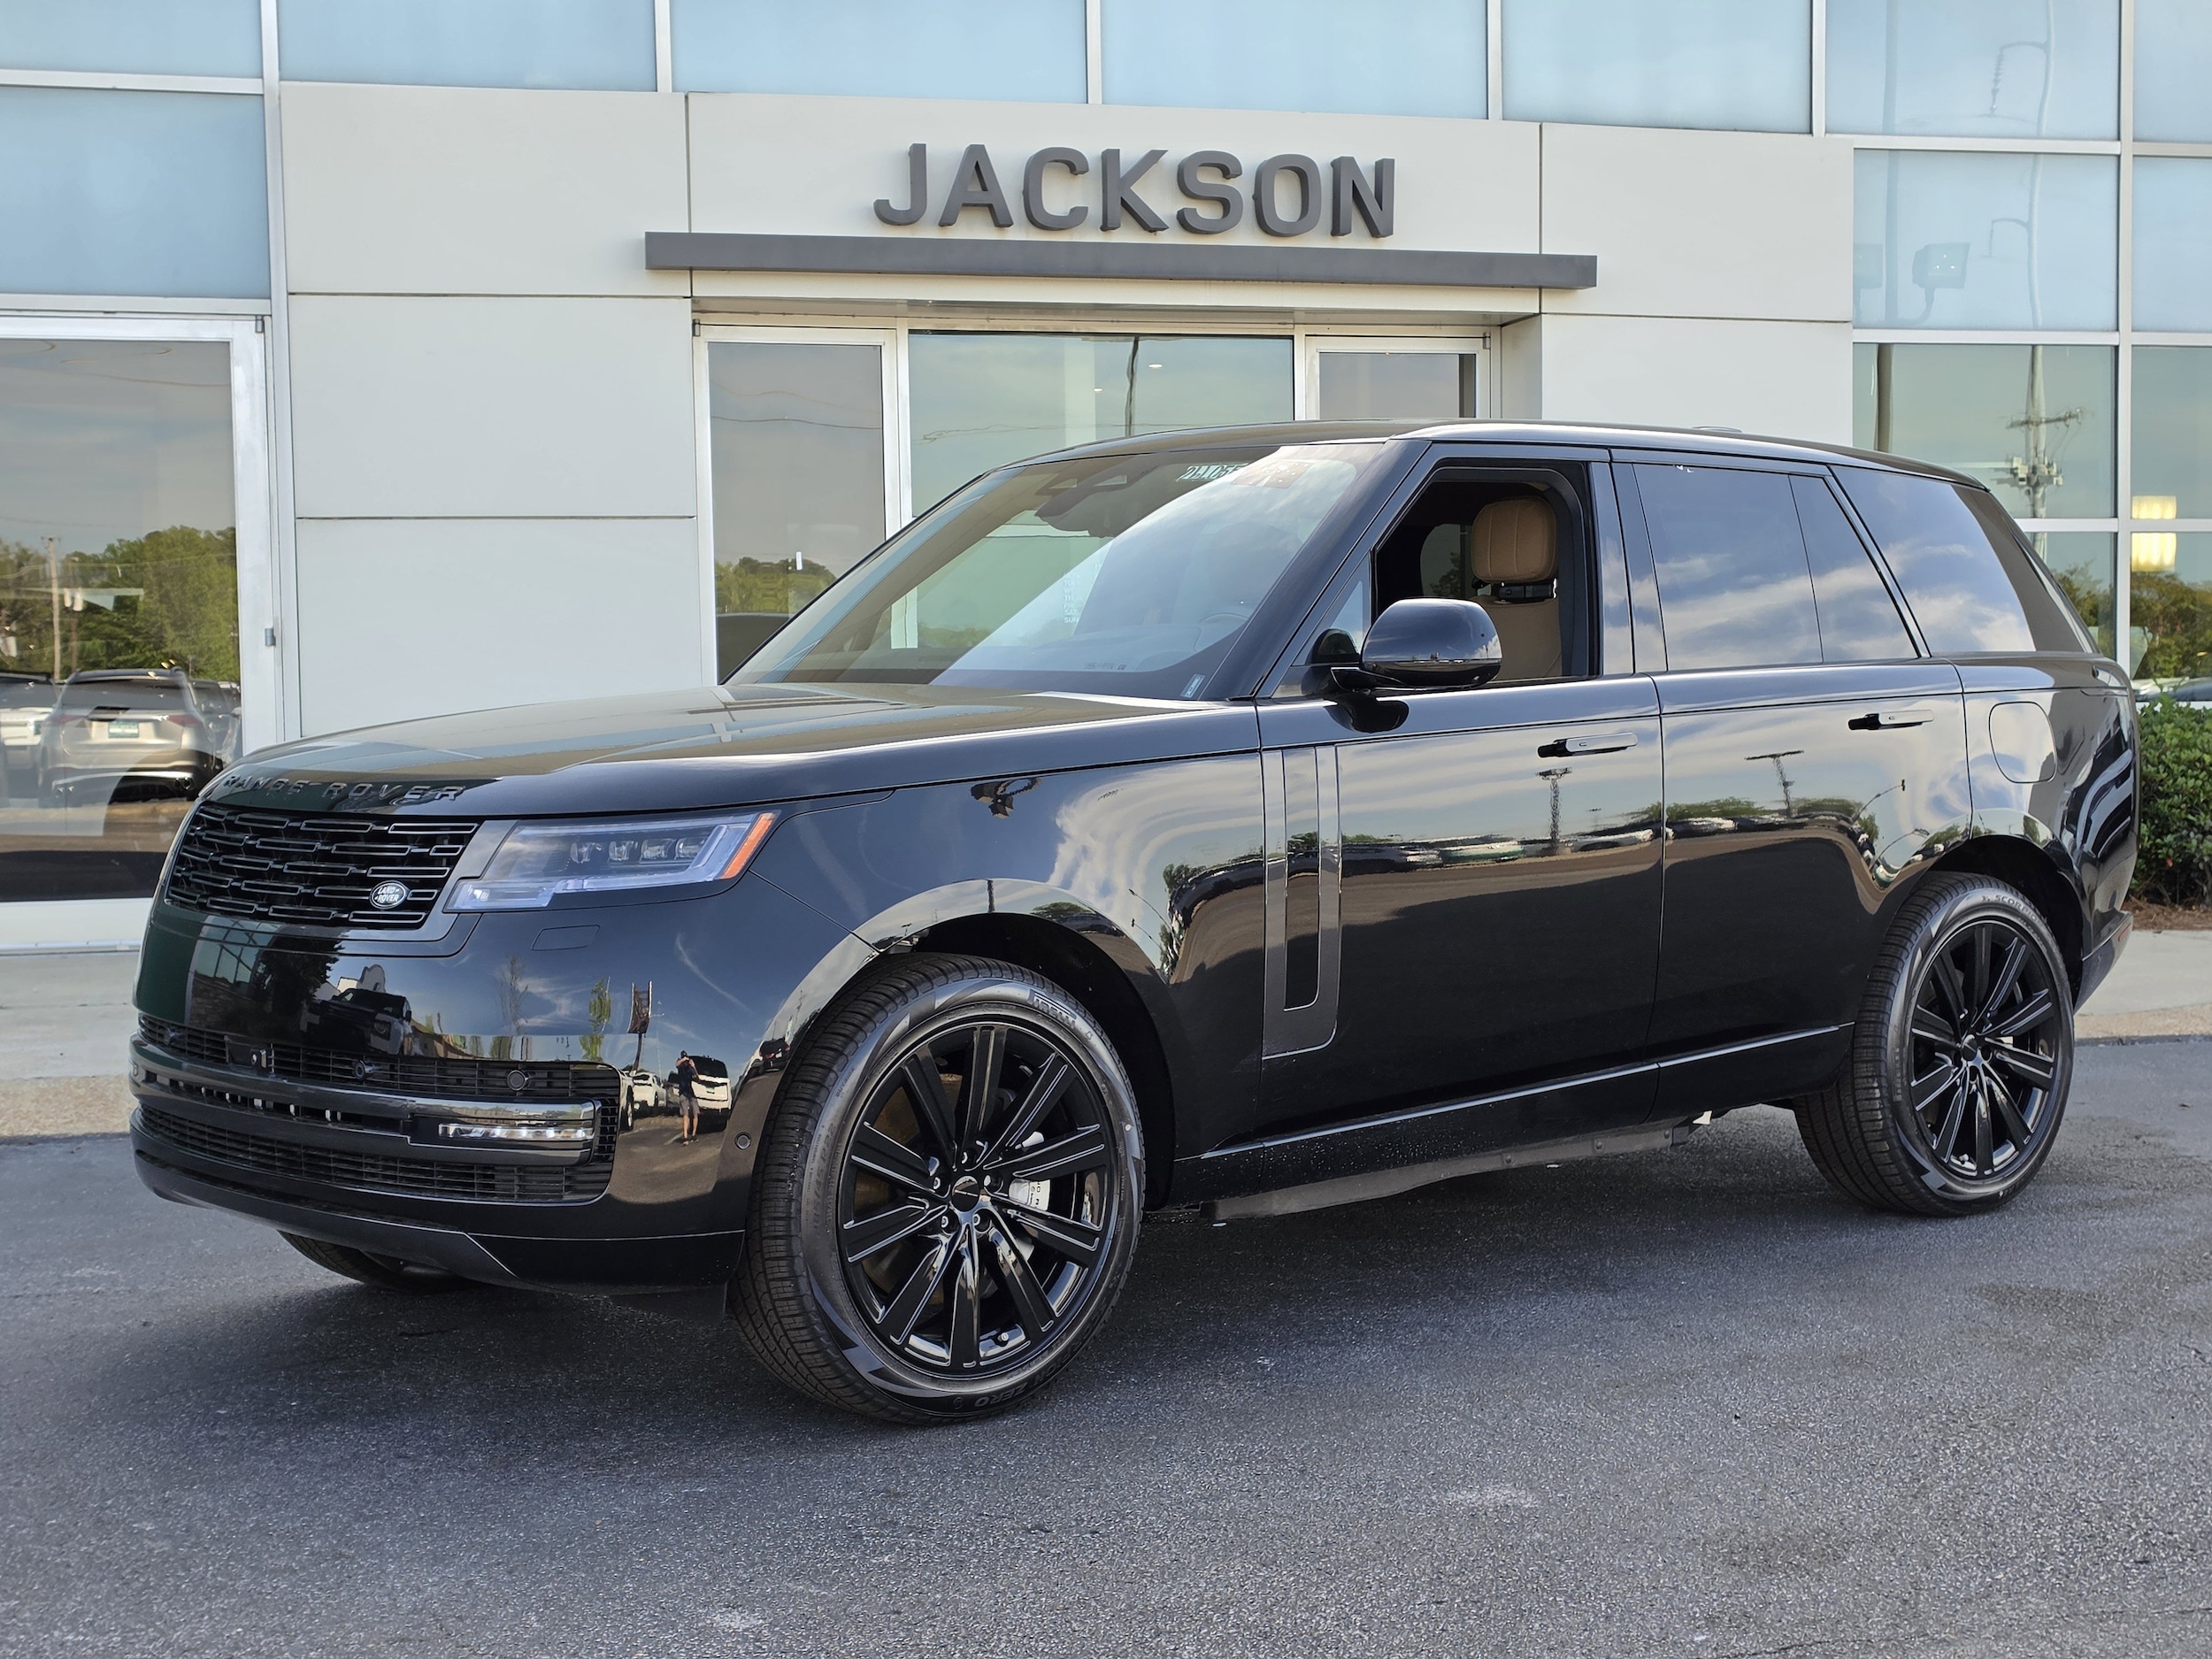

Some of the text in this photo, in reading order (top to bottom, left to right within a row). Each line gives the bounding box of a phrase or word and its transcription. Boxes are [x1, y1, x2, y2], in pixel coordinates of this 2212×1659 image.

[873, 142, 1395, 238] JACKSON
[223, 775, 466, 801] RANGE ROVER
[377, 895, 399, 903] ROVER
[378, 886, 396, 895] LAND
[1027, 988, 1078, 1029] PIRELLI
[975, 1382, 1028, 1408] ZERO
